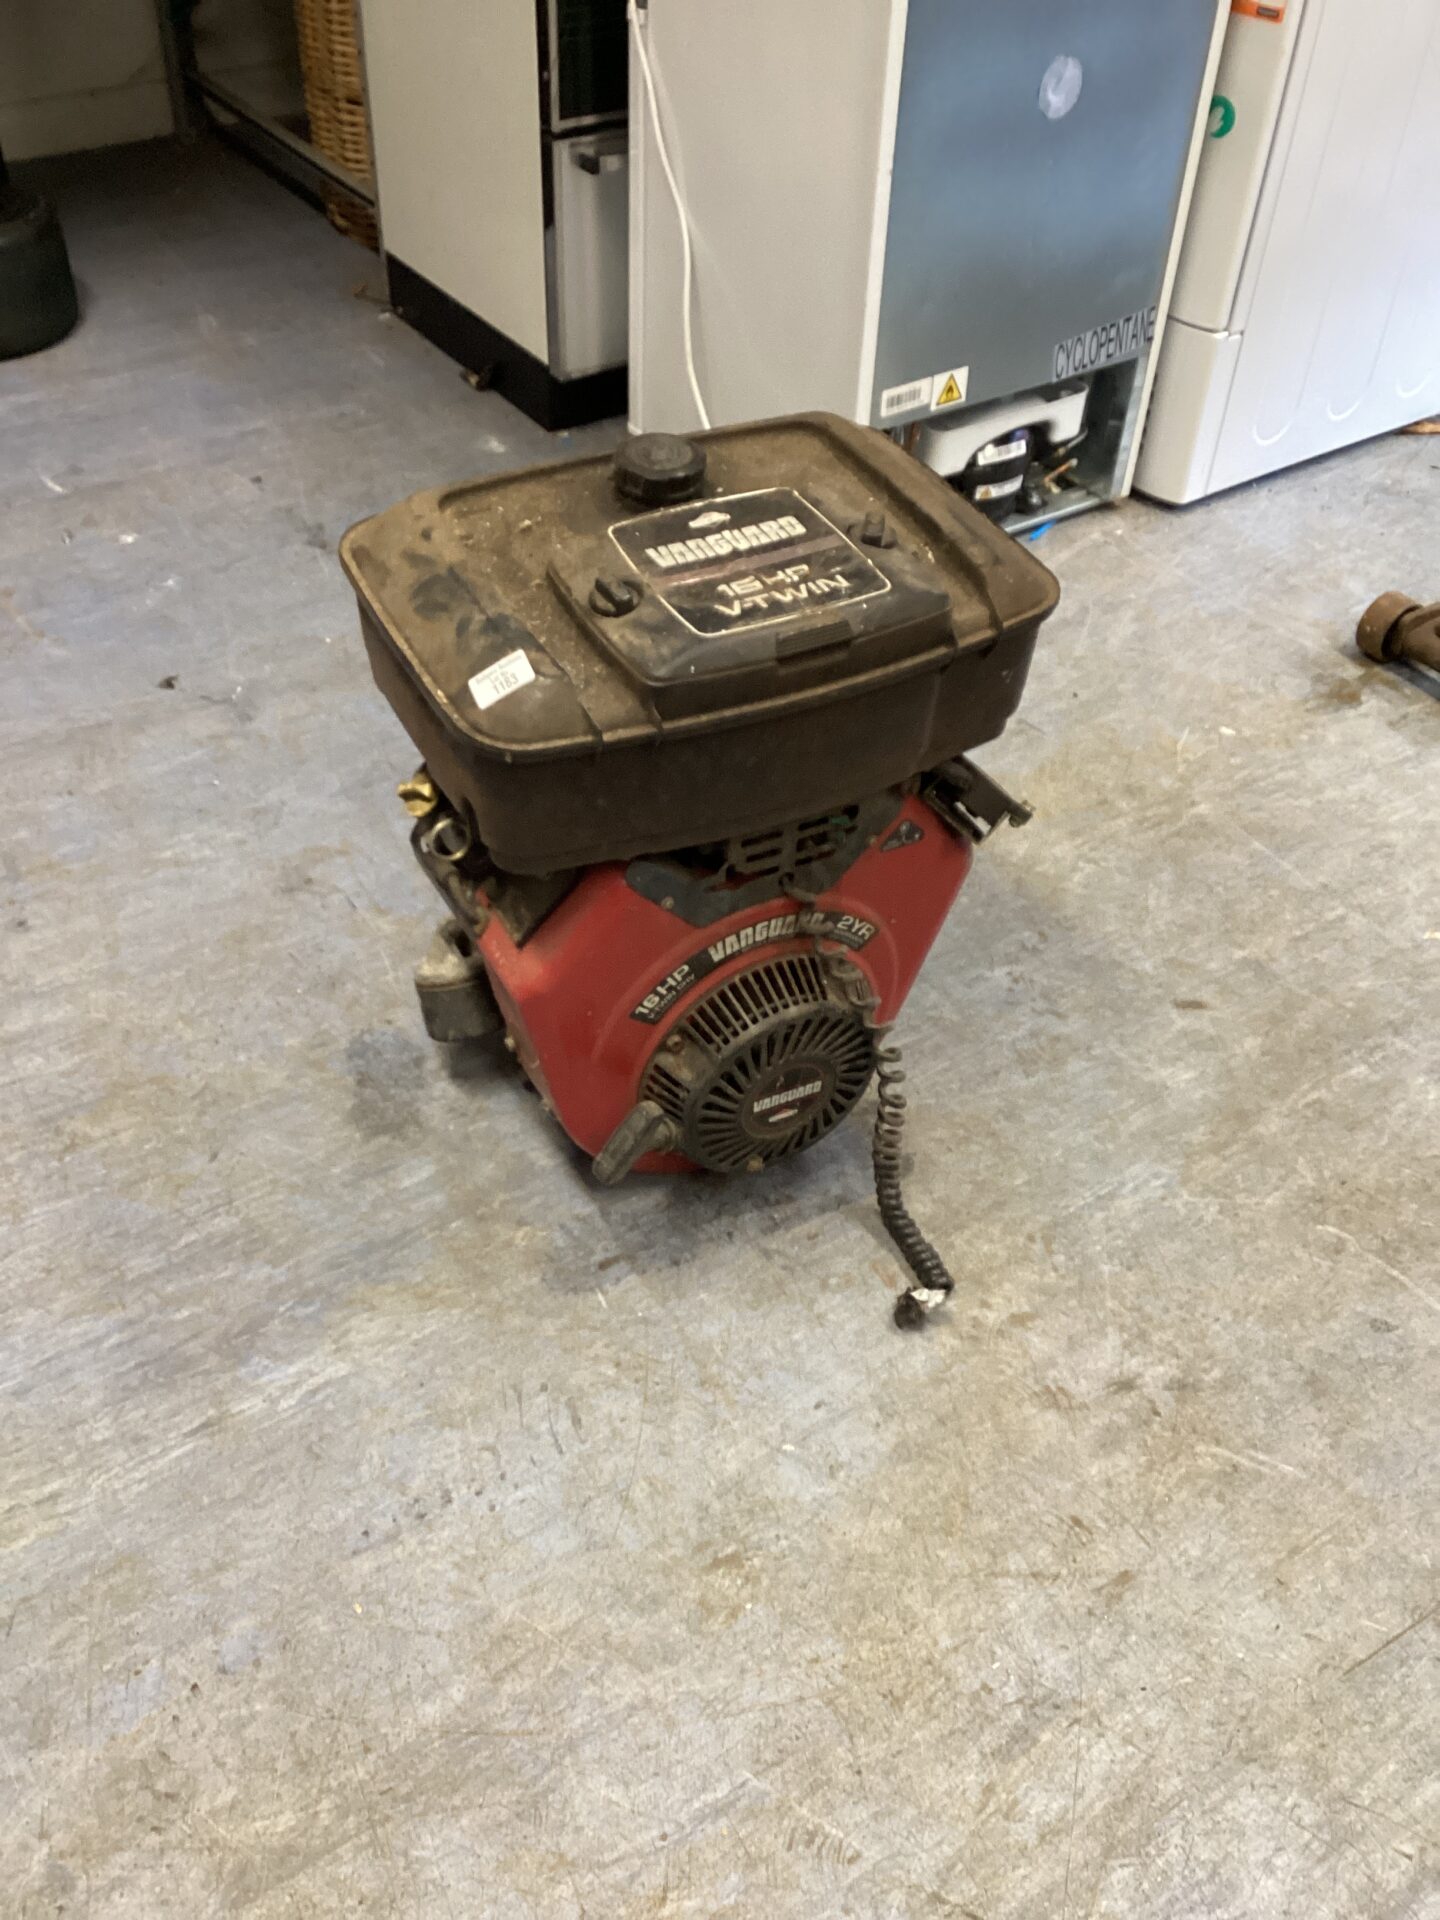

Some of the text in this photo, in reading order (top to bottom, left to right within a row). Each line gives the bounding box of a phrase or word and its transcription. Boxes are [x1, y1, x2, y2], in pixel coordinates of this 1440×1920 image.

[1055, 305, 1157, 379] CYCLOPENTANE
[644, 515, 807, 568] VANGUARD
[713, 574, 852, 616] V-TWIN
[836, 914, 876, 941] 2YR
[752, 1080, 823, 1113] VANGUARD
